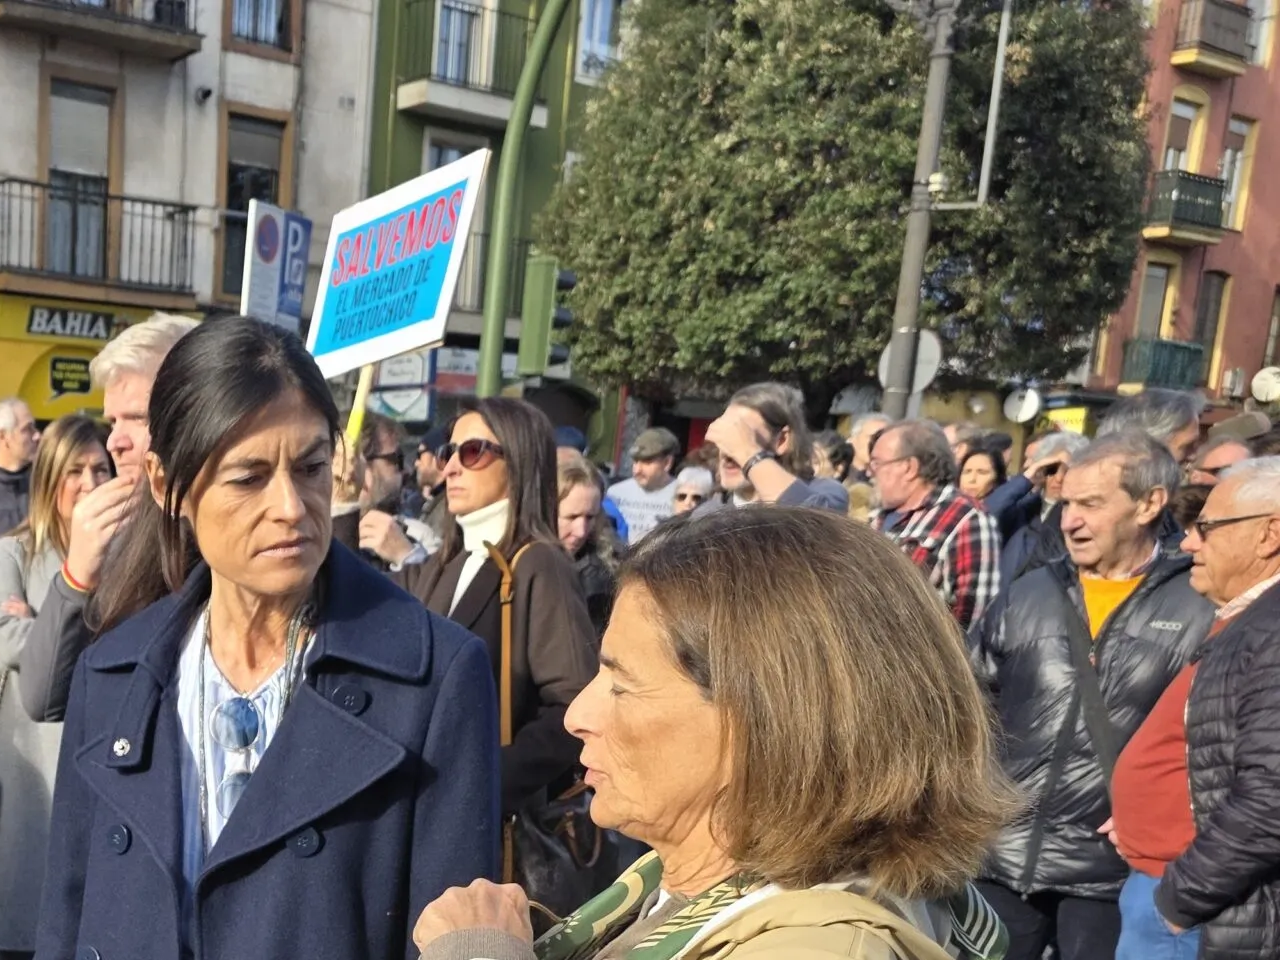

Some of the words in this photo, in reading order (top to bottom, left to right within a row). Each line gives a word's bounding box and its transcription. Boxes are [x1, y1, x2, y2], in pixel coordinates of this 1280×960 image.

[331, 189, 463, 287] SALVEMOS
[335, 290, 349, 316] EL
[352, 262, 414, 308] MERCADO
[414, 255, 435, 286] DE
[30, 307, 108, 339] BAHIA
[332, 290, 418, 344] PUERTOCHICO
